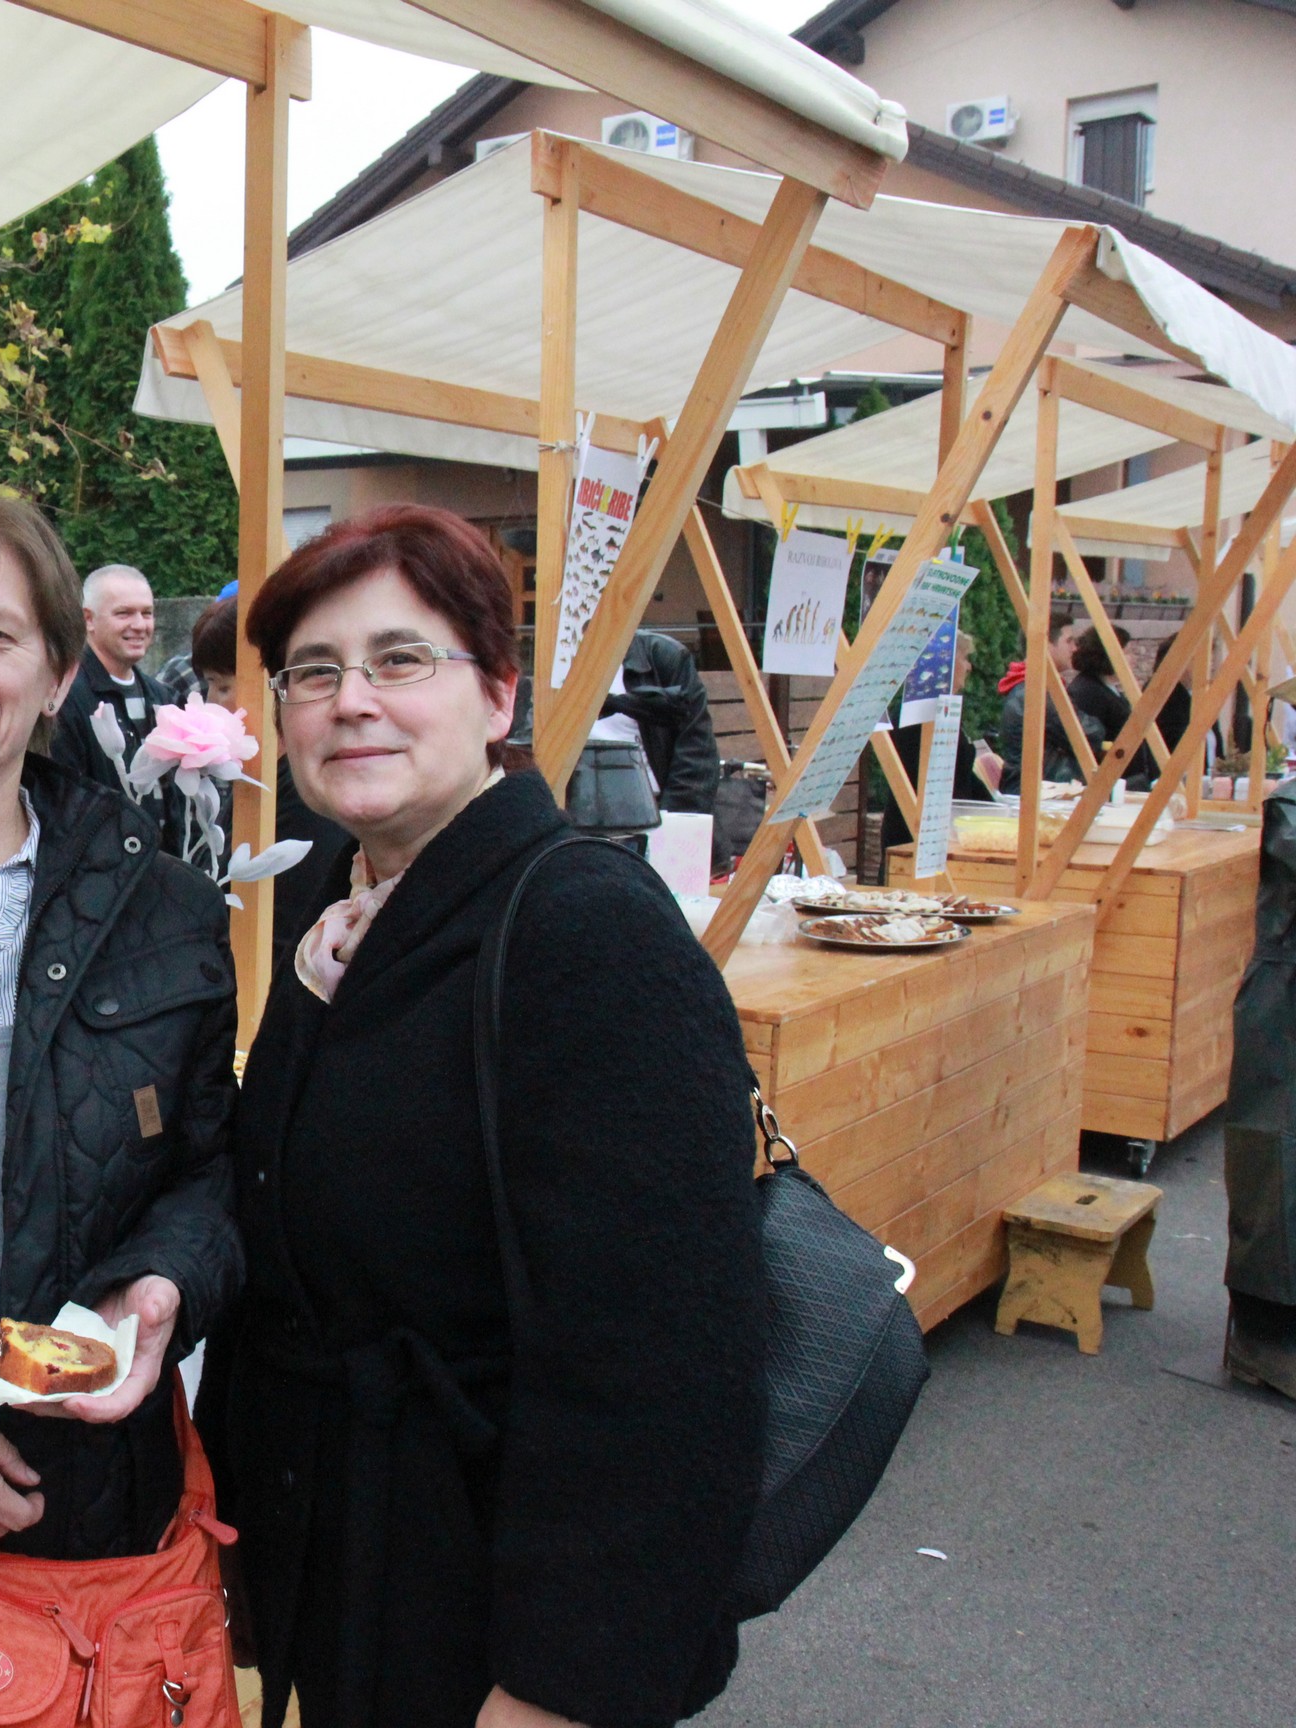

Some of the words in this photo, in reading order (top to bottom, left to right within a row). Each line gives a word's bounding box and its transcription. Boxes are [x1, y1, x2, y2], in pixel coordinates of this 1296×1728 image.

[599, 484, 612, 513] &
[606, 488, 633, 522] RIBE
[787, 551, 815, 567] RAZVOJ
